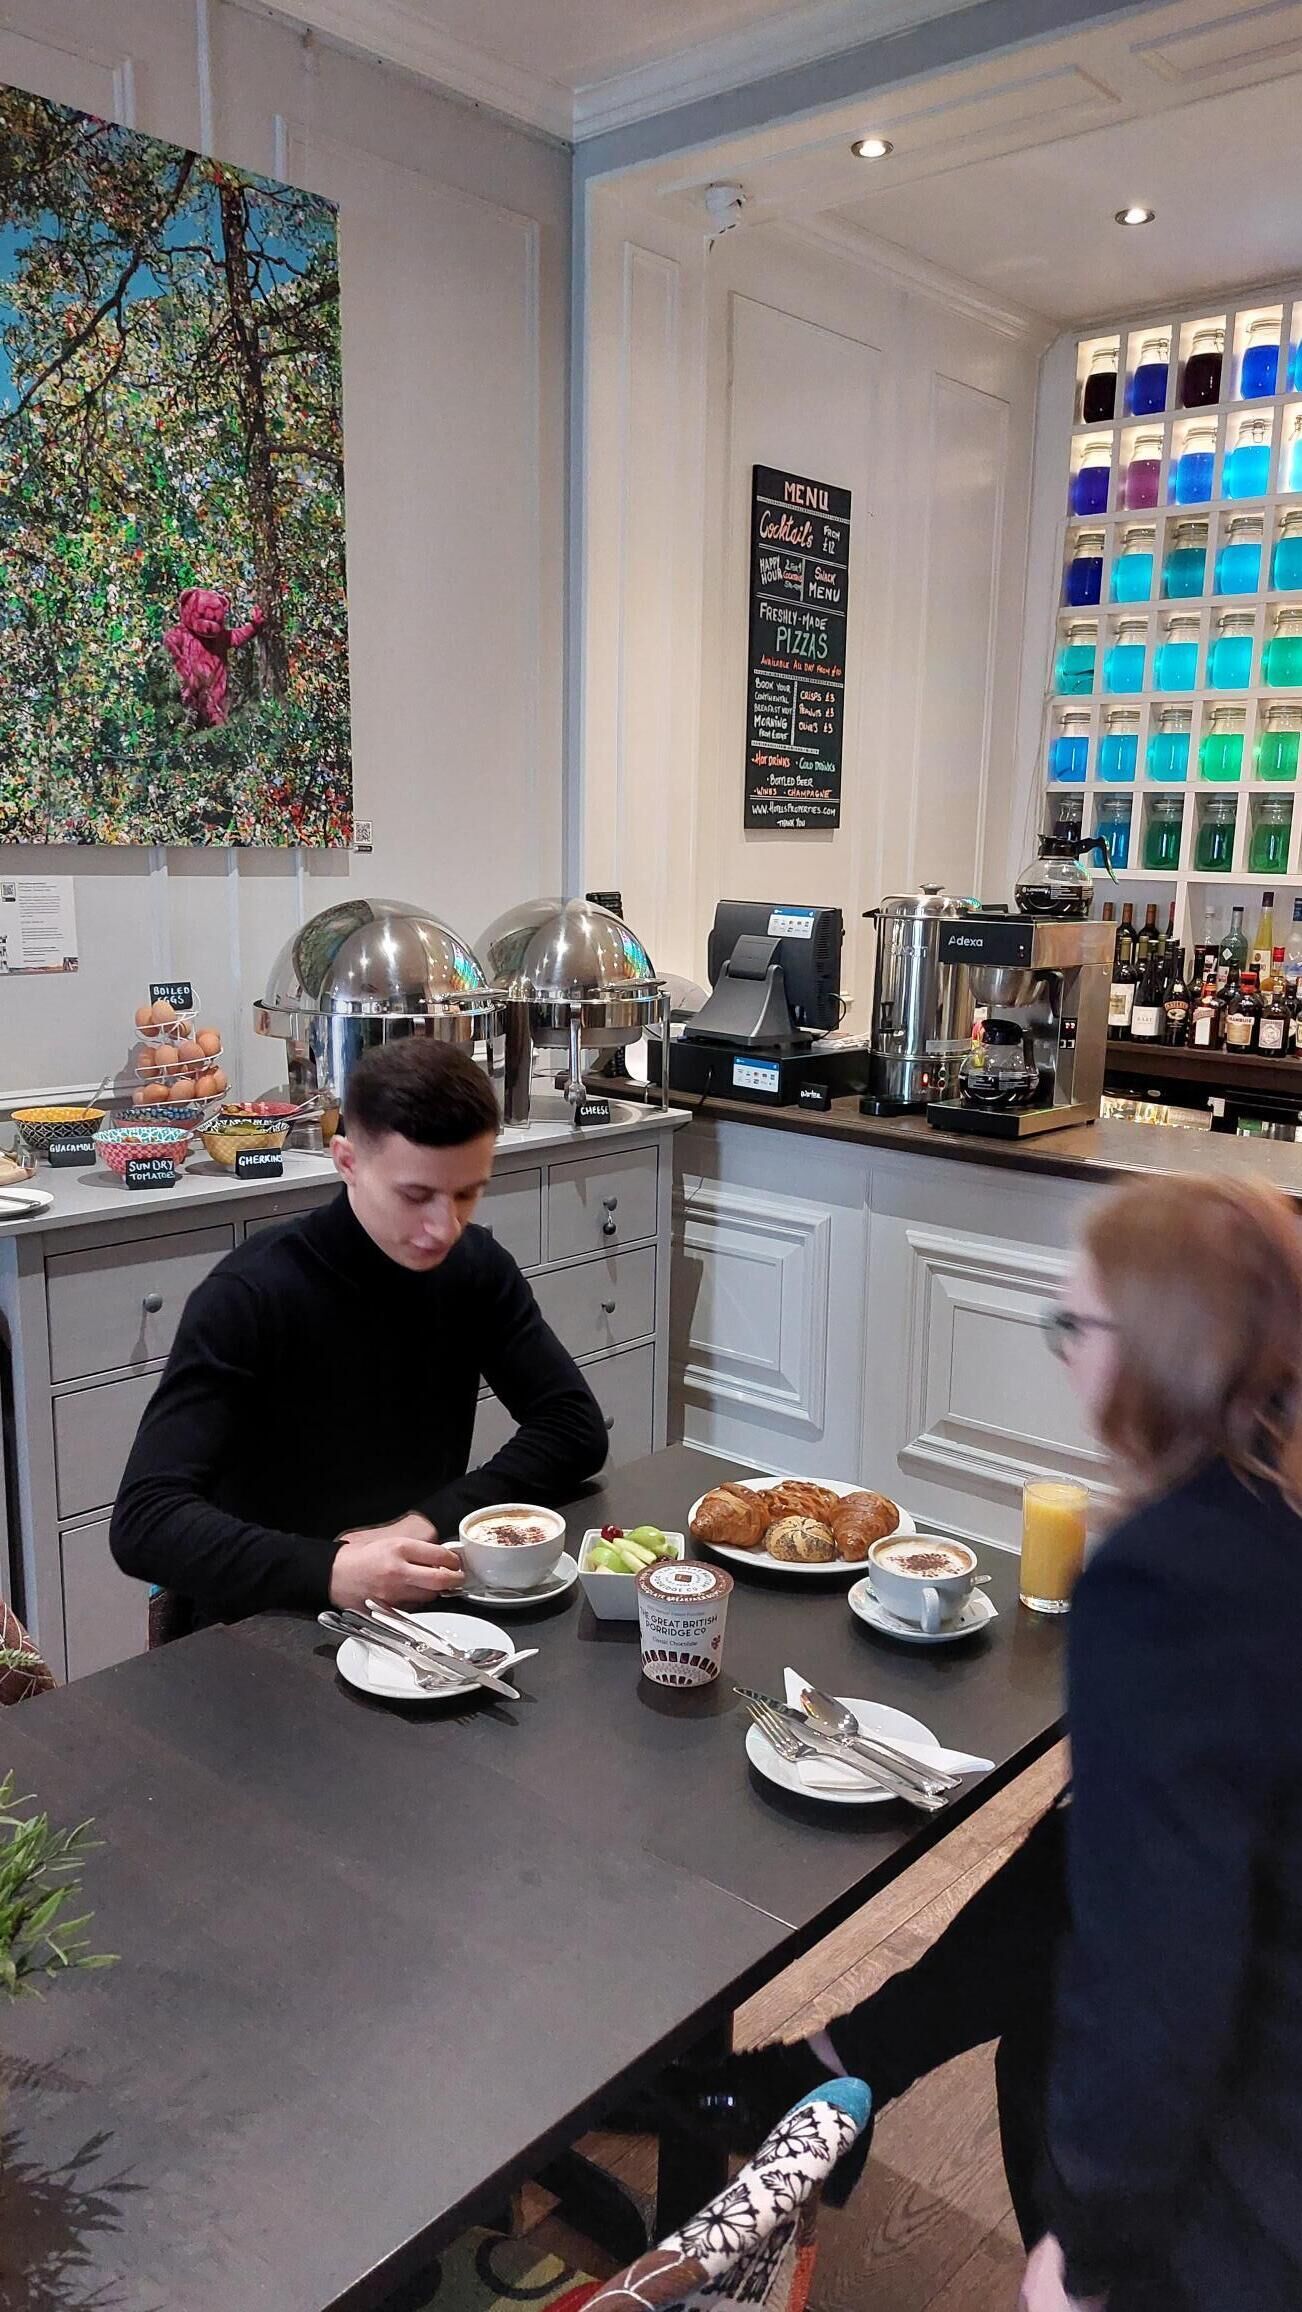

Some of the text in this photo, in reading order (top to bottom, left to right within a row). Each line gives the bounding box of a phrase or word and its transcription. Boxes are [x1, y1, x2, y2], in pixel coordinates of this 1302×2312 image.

[784, 481, 829, 511] MENU
[824, 525, 841, 542] FROM
[760, 555, 780, 573] HAPPY
[761, 568, 783, 585] HOUR
[814, 566, 837, 585] SNACK
[809, 582, 841, 602] MENU
[776, 626, 828, 660] PIZZAS
[755, 677, 791, 693] BOOK YOUR
[800, 690, 822, 702] CRISPS
[754, 714, 788, 729] MORNING
[769, 773, 814, 787] BOTTLED BEER
[756, 786, 777, 796] WINES
[787, 787, 833, 798] CHAMPAGNE
[948, 935, 984, 947] Adexa
[153, 986, 190, 995] BOILED
[128, 1159, 174, 1172] SUN DRY
[238, 1154, 283, 1167] GHERKINS
[128, 1171, 176, 1181] TOMATOES
[651, 1615, 680, 1628] GREAT
[683, 1614, 718, 1628] BRITISH
[645, 1620, 691, 1637] PORRIDGE
